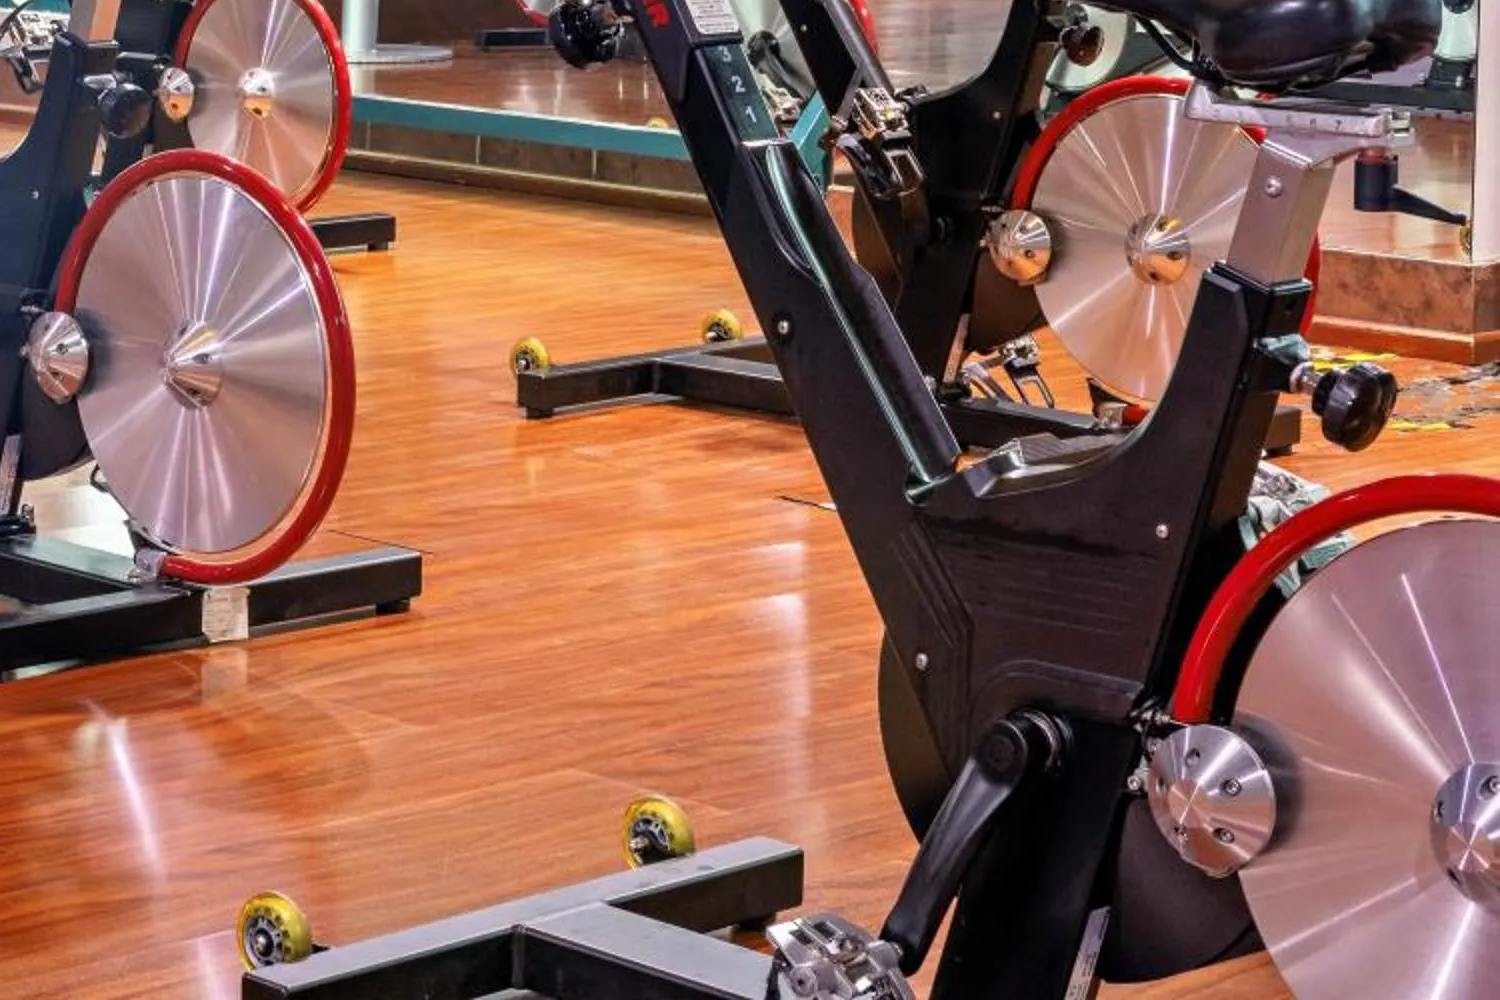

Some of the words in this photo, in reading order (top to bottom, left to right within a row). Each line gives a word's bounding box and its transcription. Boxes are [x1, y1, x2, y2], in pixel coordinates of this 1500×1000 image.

[718, 45, 732, 63] 3
[731, 75, 746, 93] 2
[745, 105, 757, 123] 1
